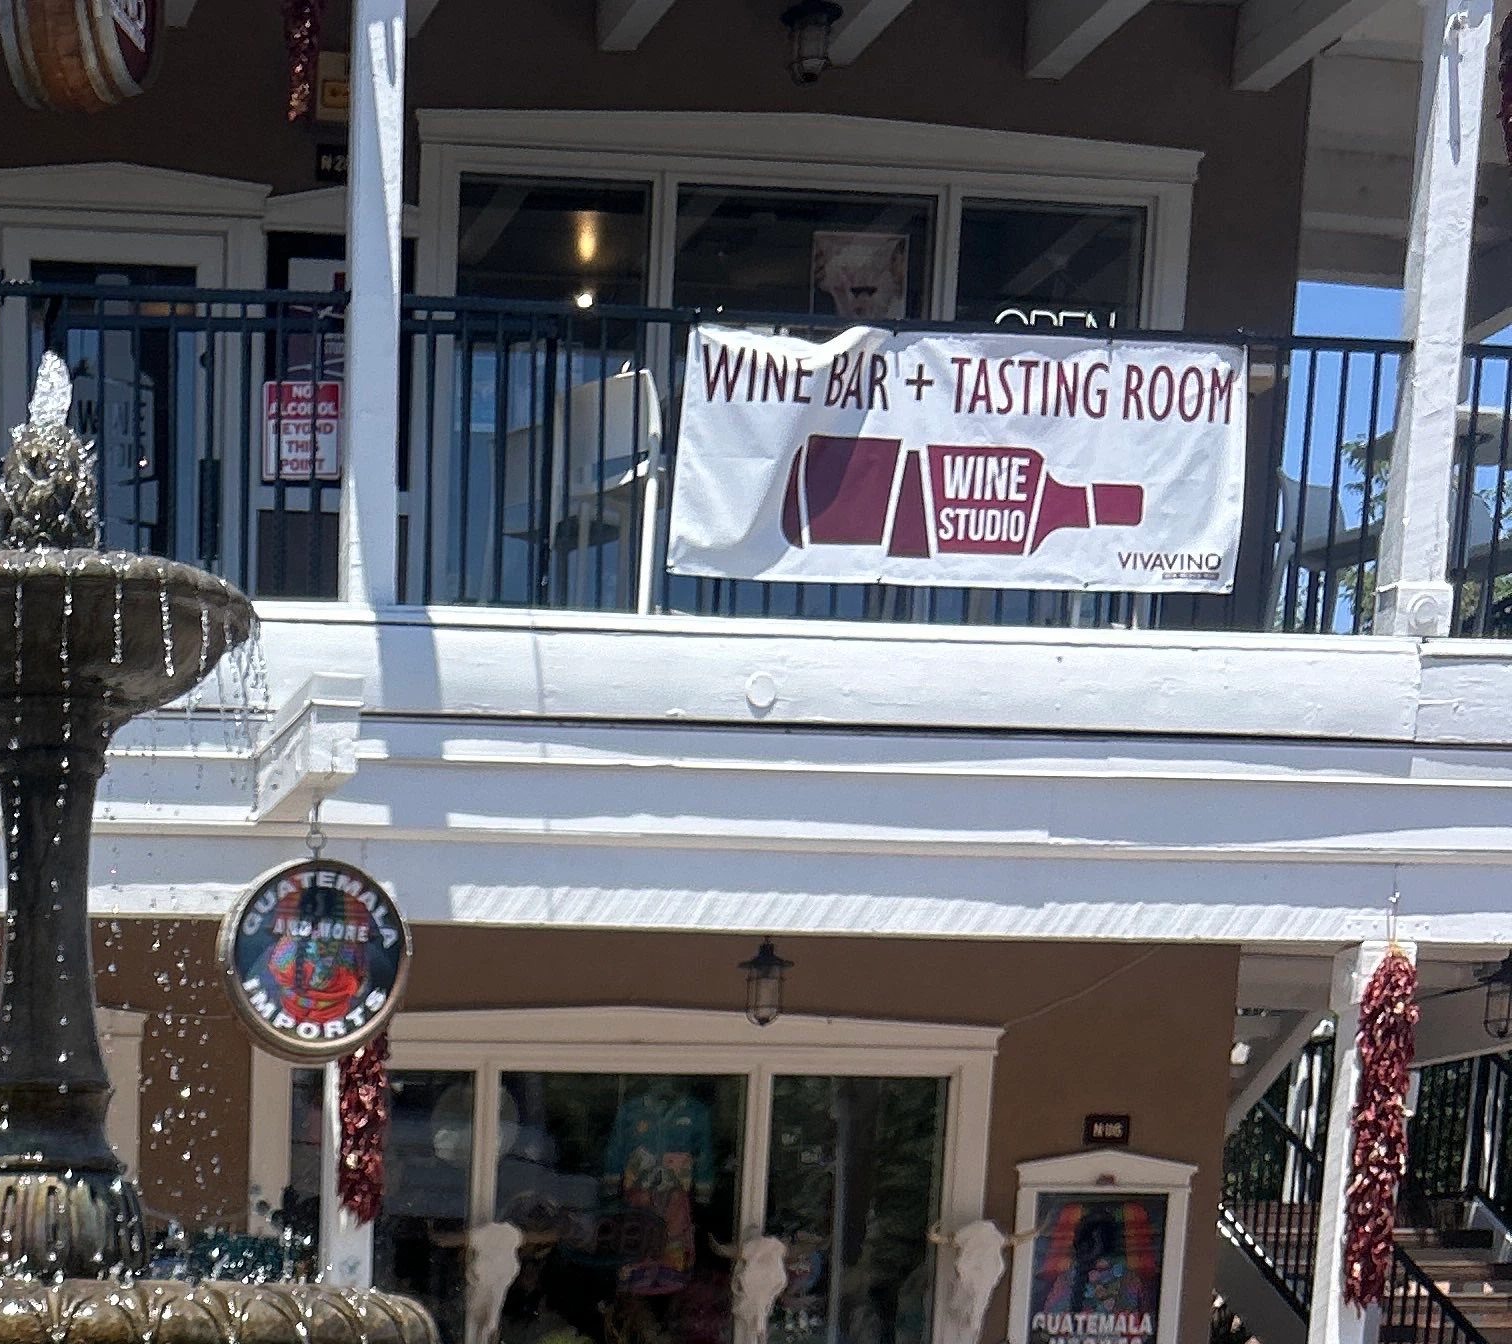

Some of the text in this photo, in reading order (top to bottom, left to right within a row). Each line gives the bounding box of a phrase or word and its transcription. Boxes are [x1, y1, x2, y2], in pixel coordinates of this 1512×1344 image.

[292, 385, 312, 399] NO
[702, 344, 1235, 425] WINE BAR + TASTING ROOM
[942, 454, 1030, 502] WINE
[938, 506, 1025, 542] STUDIO
[1117, 551, 1222, 571] VIVAVINO
[242, 870, 399, 949] GUATEMALA
[272, 918, 369, 943] AND MORE
[242, 976, 387, 1039] IMPORTS
[1032, 1312, 1153, 1336] GUATEMALA
